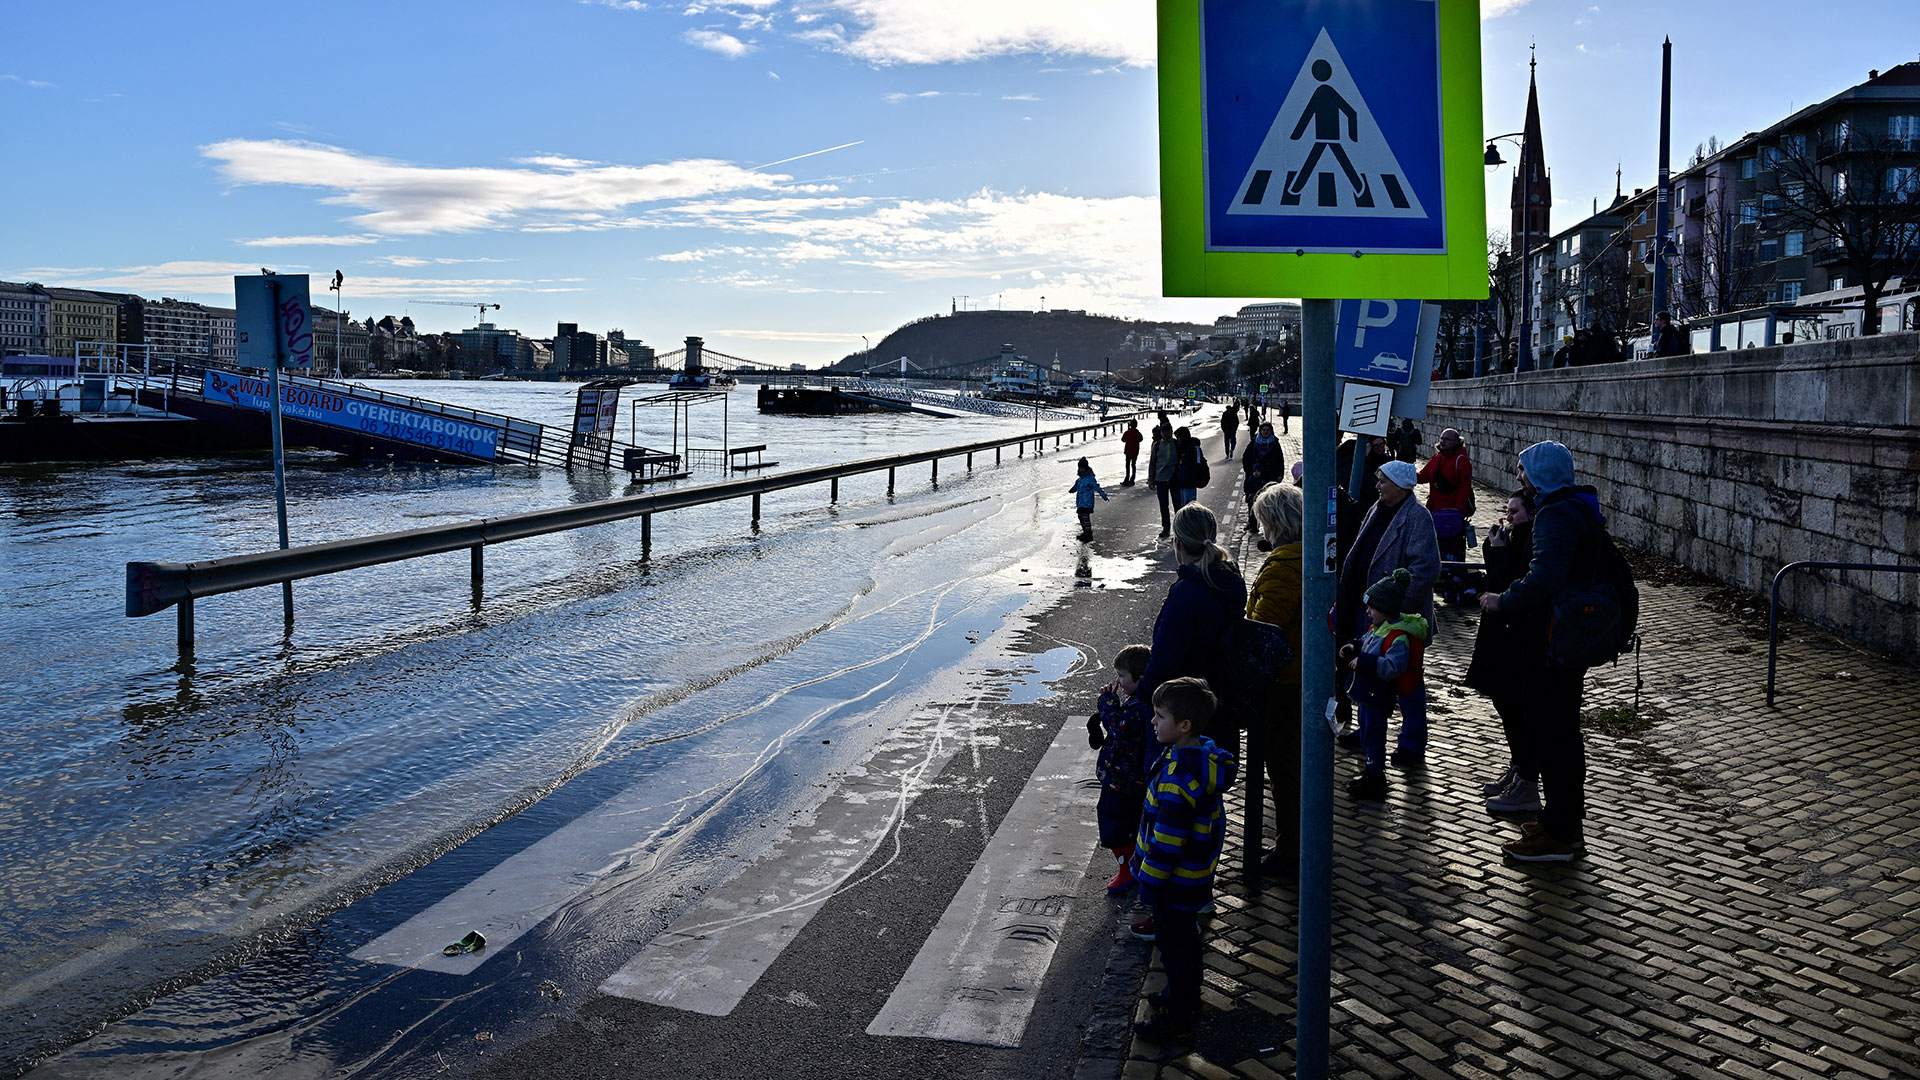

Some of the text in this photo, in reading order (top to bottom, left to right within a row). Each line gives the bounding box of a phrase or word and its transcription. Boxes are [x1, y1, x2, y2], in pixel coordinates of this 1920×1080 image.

[1354, 299, 1398, 348] P
[252, 396, 323, 420] lupwake.hu
[360, 417, 475, 454] 06 20/546 8140
